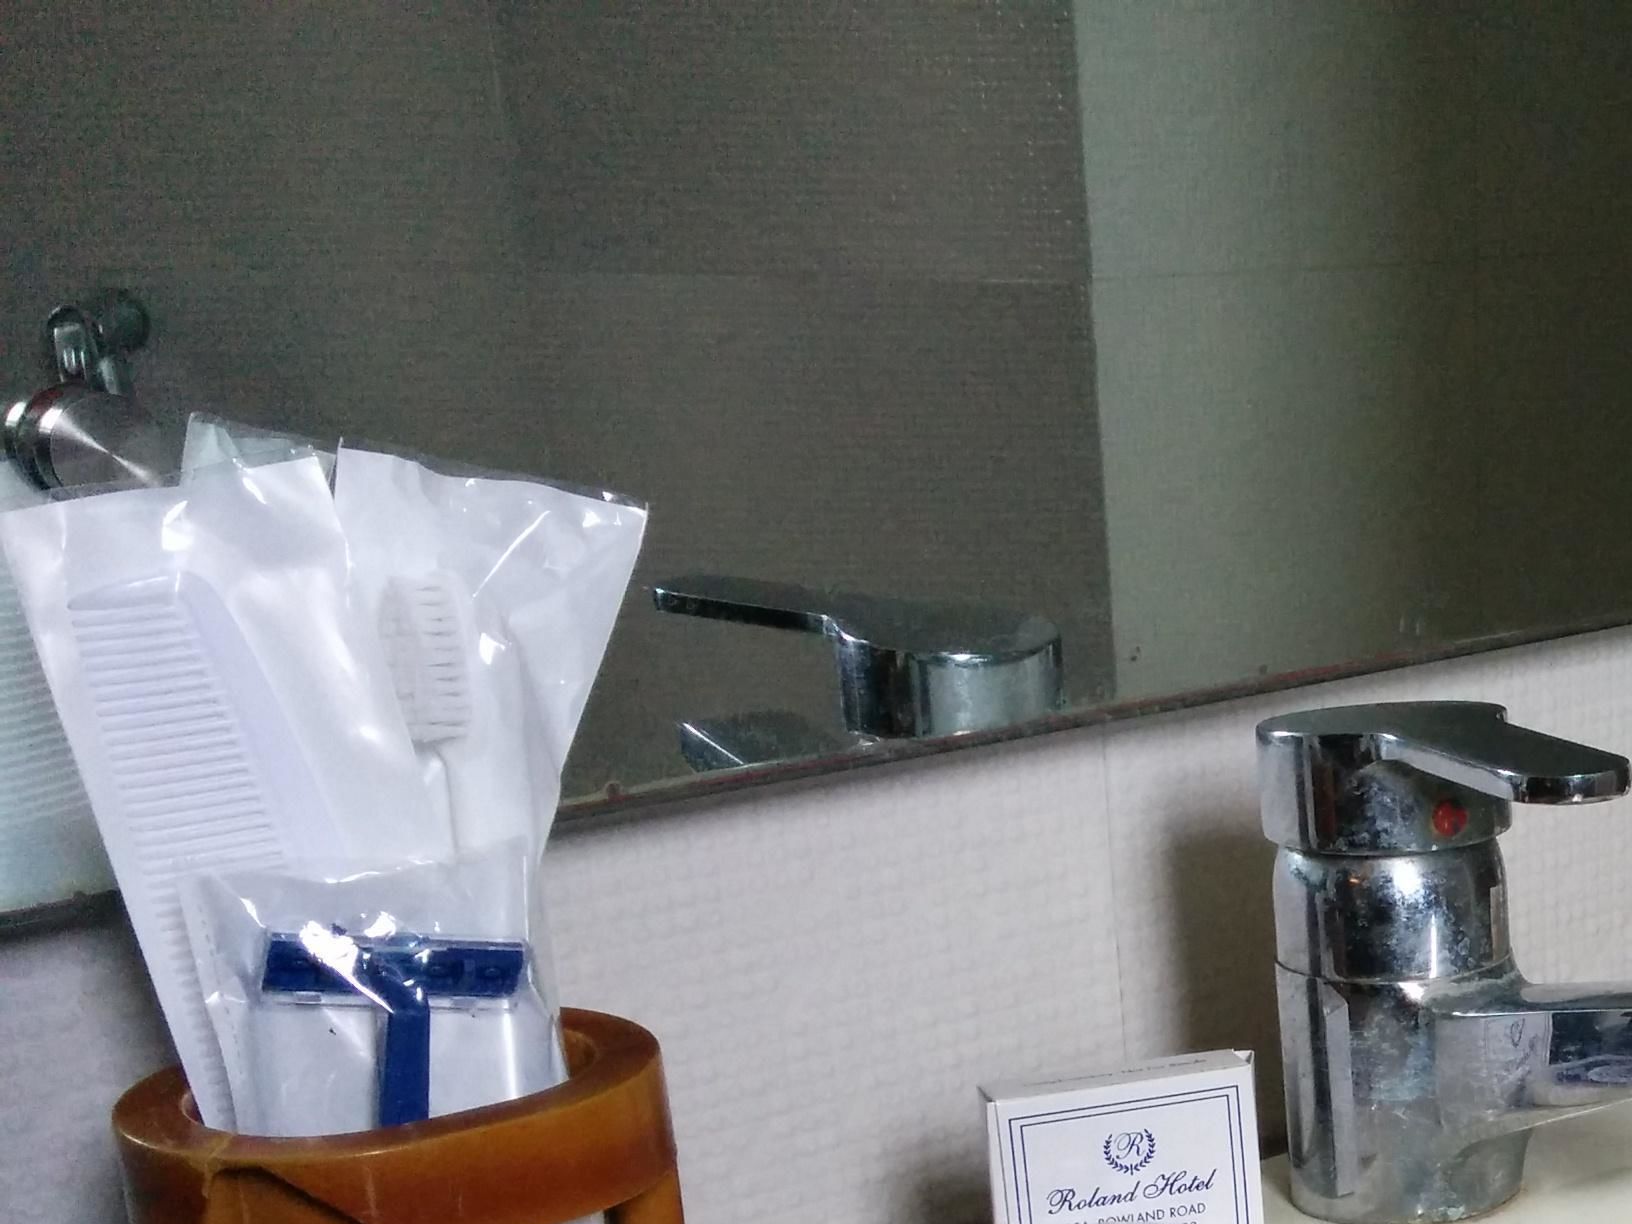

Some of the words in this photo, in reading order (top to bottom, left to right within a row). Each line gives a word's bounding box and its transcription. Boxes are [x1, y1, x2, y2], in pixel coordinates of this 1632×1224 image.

[1046, 1180, 1141, 1215] Roland
[1143, 1168, 1218, 1200] Hotel
[1169, 1202, 1206, 1218] ROAD
